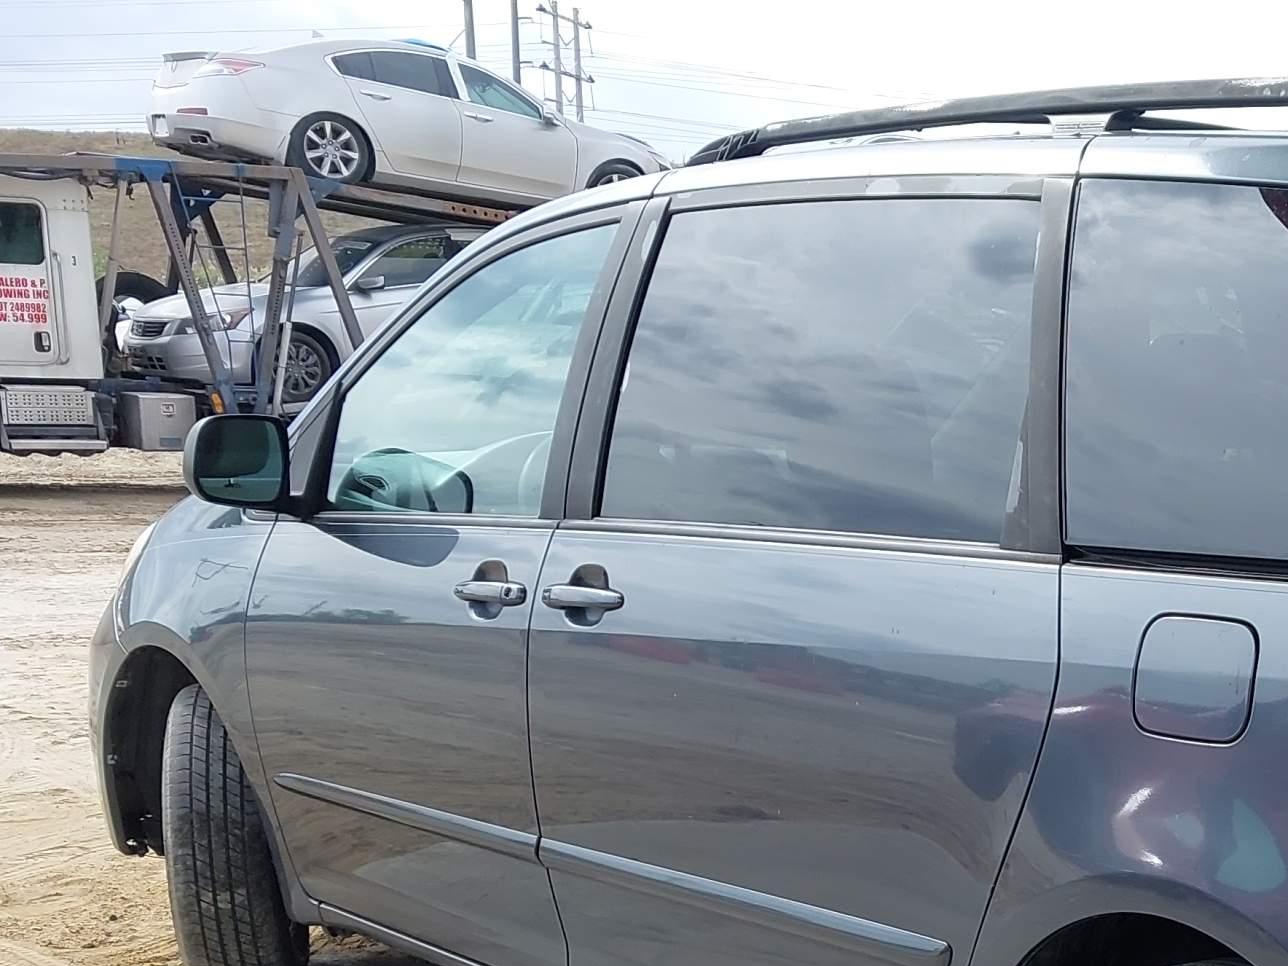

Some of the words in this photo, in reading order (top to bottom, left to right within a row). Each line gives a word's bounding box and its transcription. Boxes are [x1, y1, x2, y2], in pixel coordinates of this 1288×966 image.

[30, 279, 37, 288] &
[32, 289, 49, 300] INC
[9, 302, 46, 313] 2489982
